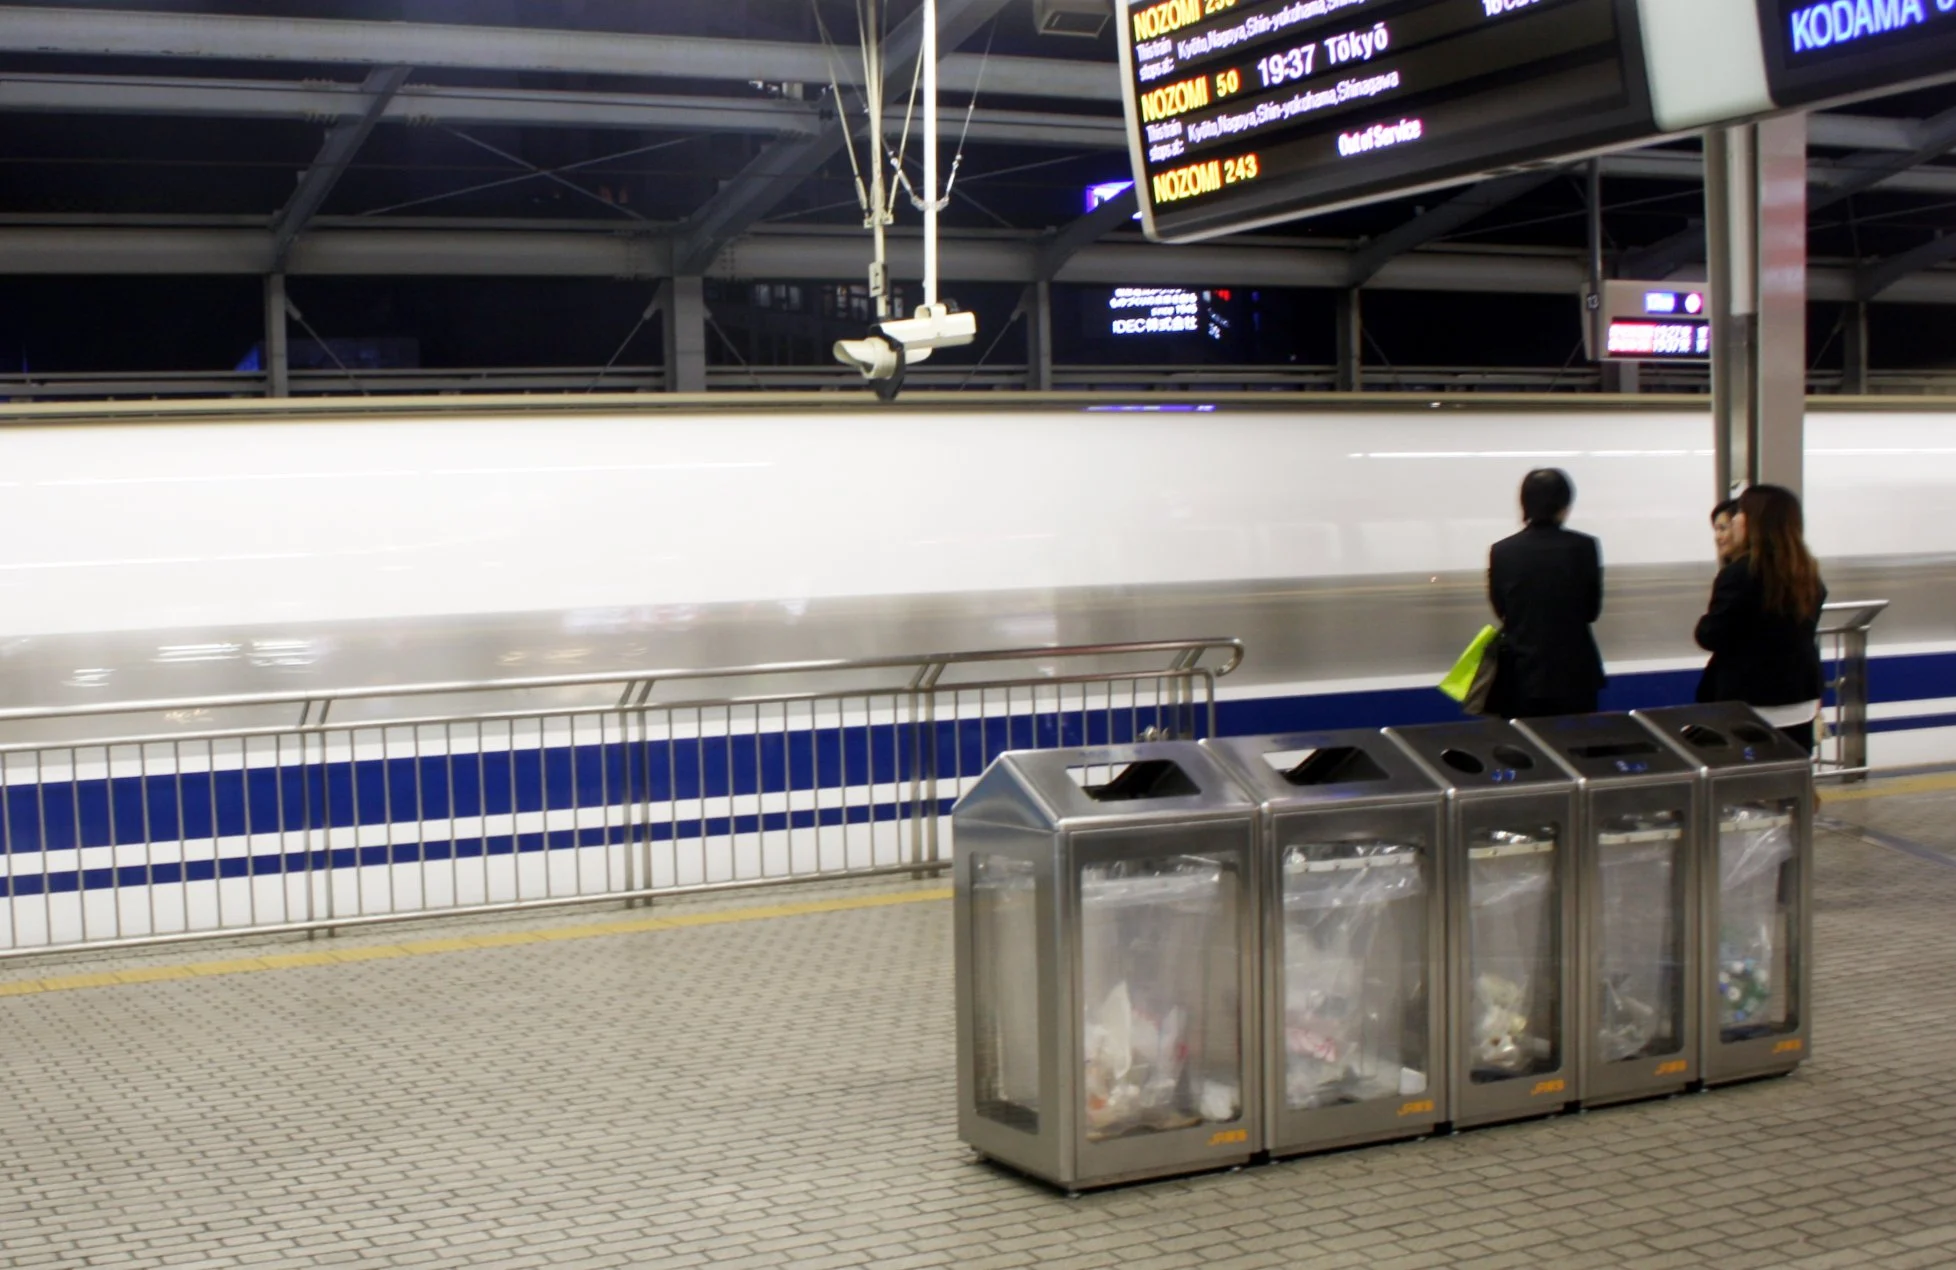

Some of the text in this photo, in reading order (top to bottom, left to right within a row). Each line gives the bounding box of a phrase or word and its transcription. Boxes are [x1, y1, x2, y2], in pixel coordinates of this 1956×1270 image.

[1133, 0, 1201, 42] NOZOMI
[1791, 0, 1926, 53] KODAMA
[1141, 76, 1208, 123] NOZOMI
[1216, 69, 1239, 98] 50
[1257, 43, 1316, 87] 19:37
[1373, 118, 1422, 148] Service
[1153, 154, 1258, 204] NOZOMI 243
